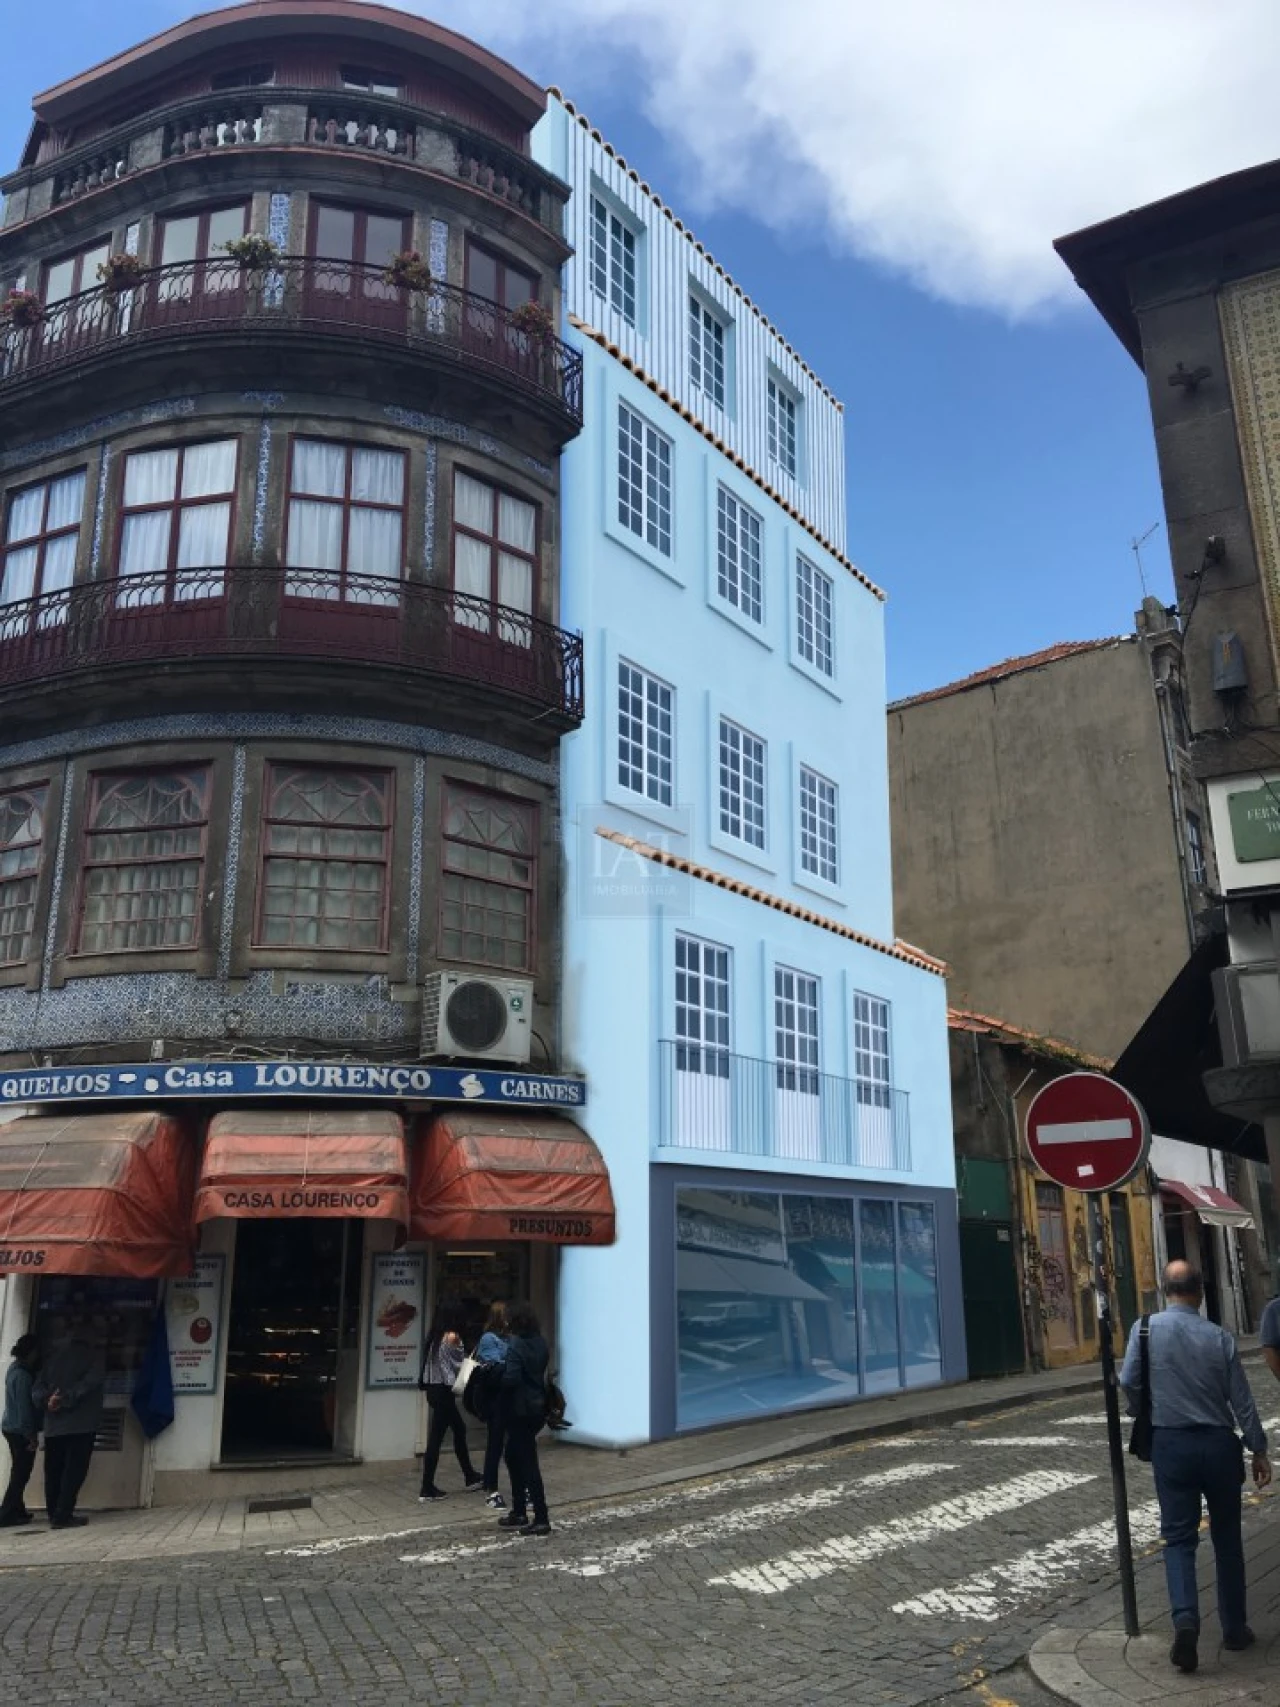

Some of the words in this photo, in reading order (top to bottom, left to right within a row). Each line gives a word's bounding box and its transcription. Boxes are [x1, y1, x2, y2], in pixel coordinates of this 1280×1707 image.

[1, 1073, 112, 1098] QUEIJOS
[164, 1066, 234, 1088] Casa
[255, 1065, 431, 1094] LOURENÇO
[500, 1079, 580, 1101] CARNES
[223, 1192, 275, 1208] CASA
[281, 1192, 380, 1209] LOURENÇO
[509, 1218, 593, 1238] PRESUNTOS
